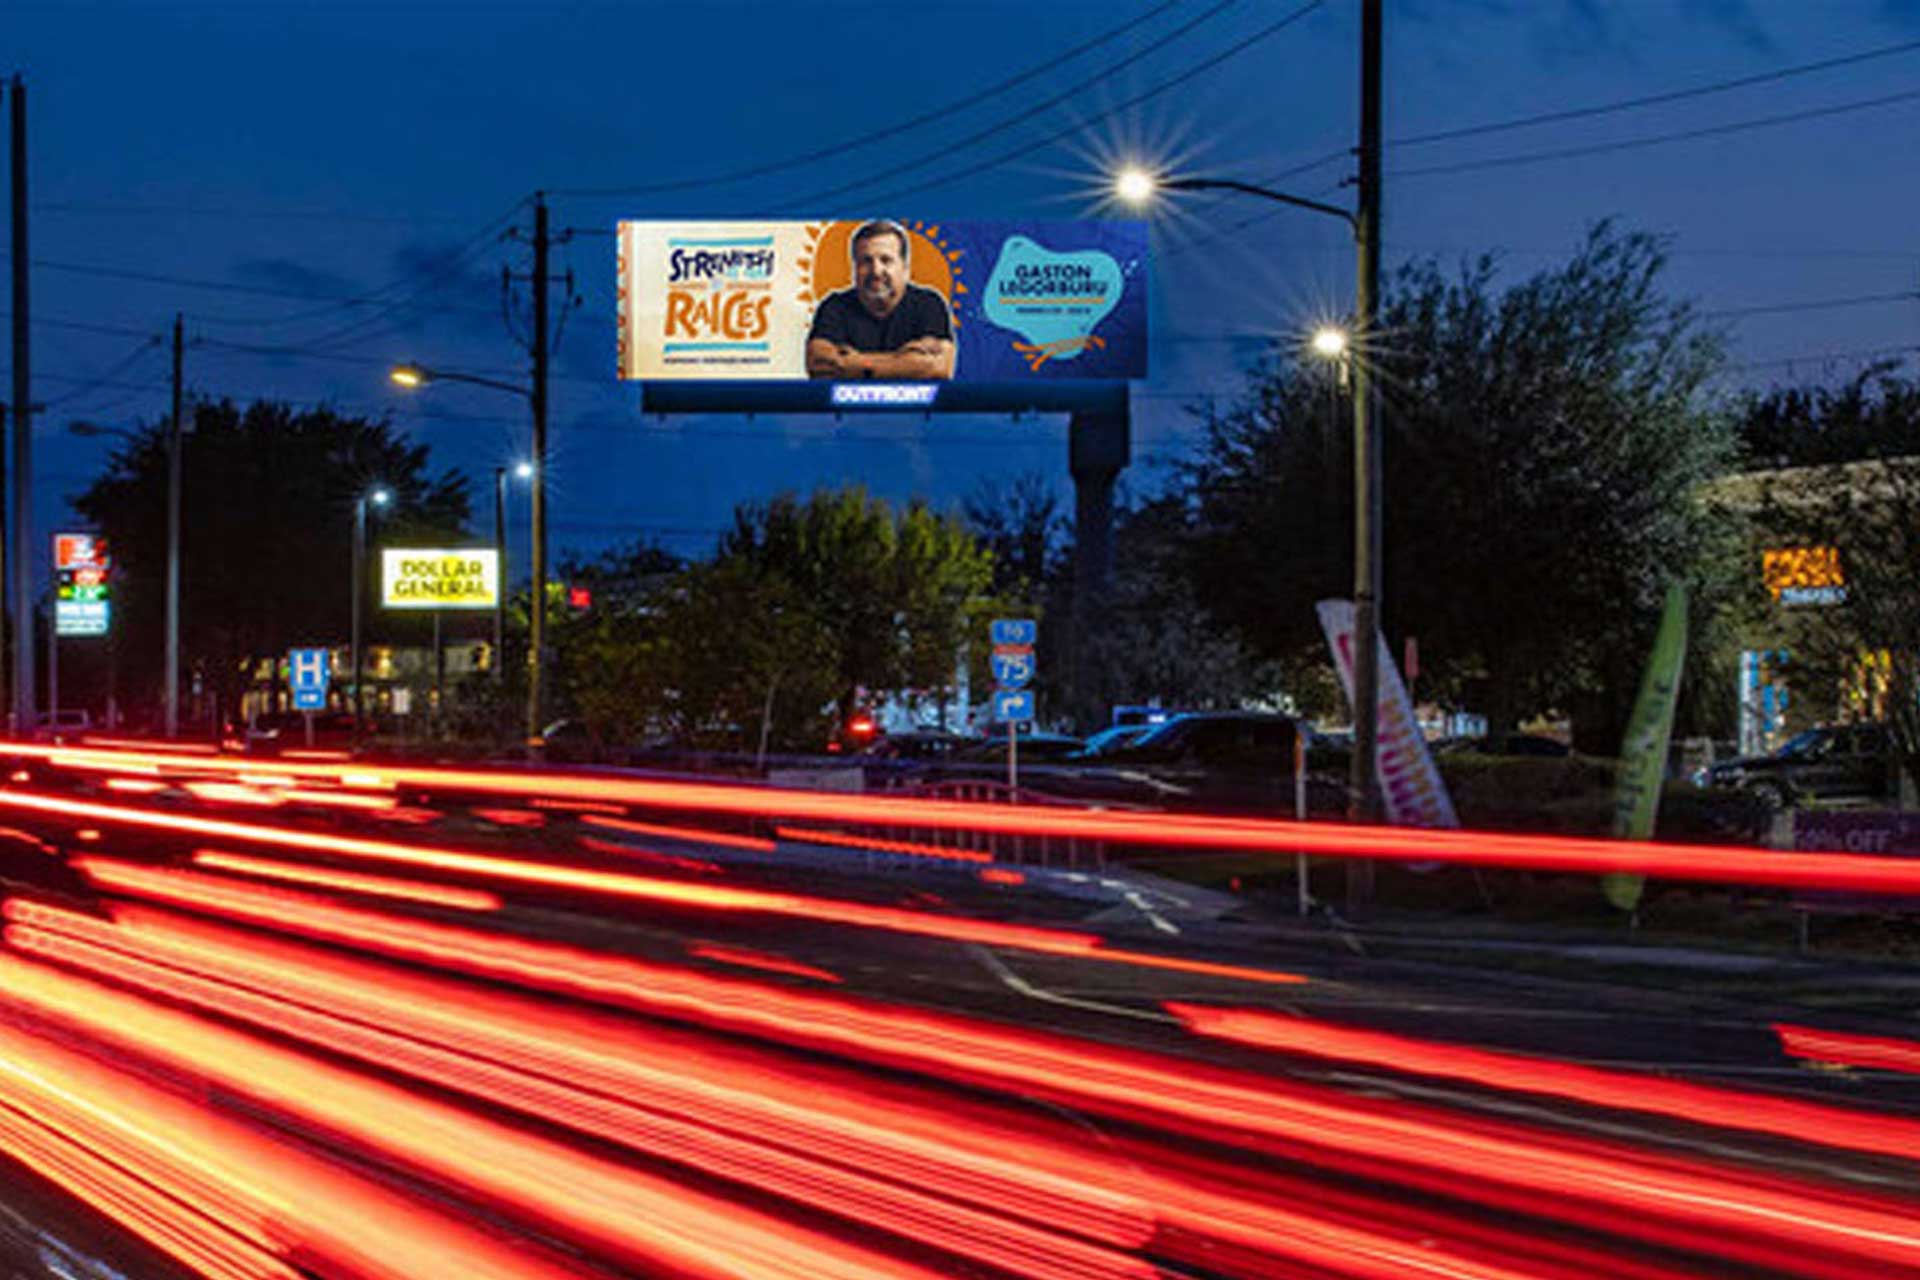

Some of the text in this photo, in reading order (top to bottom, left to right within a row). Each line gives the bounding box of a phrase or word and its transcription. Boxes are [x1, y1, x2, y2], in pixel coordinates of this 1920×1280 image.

[1015, 264, 1091, 279] GASTON
[664, 291, 772, 340] RAICES
[401, 560, 483, 577] DOLLAR
[394, 580, 488, 597] GENERAL
[295, 652, 321, 686] H
[998, 656, 1029, 680] 75
